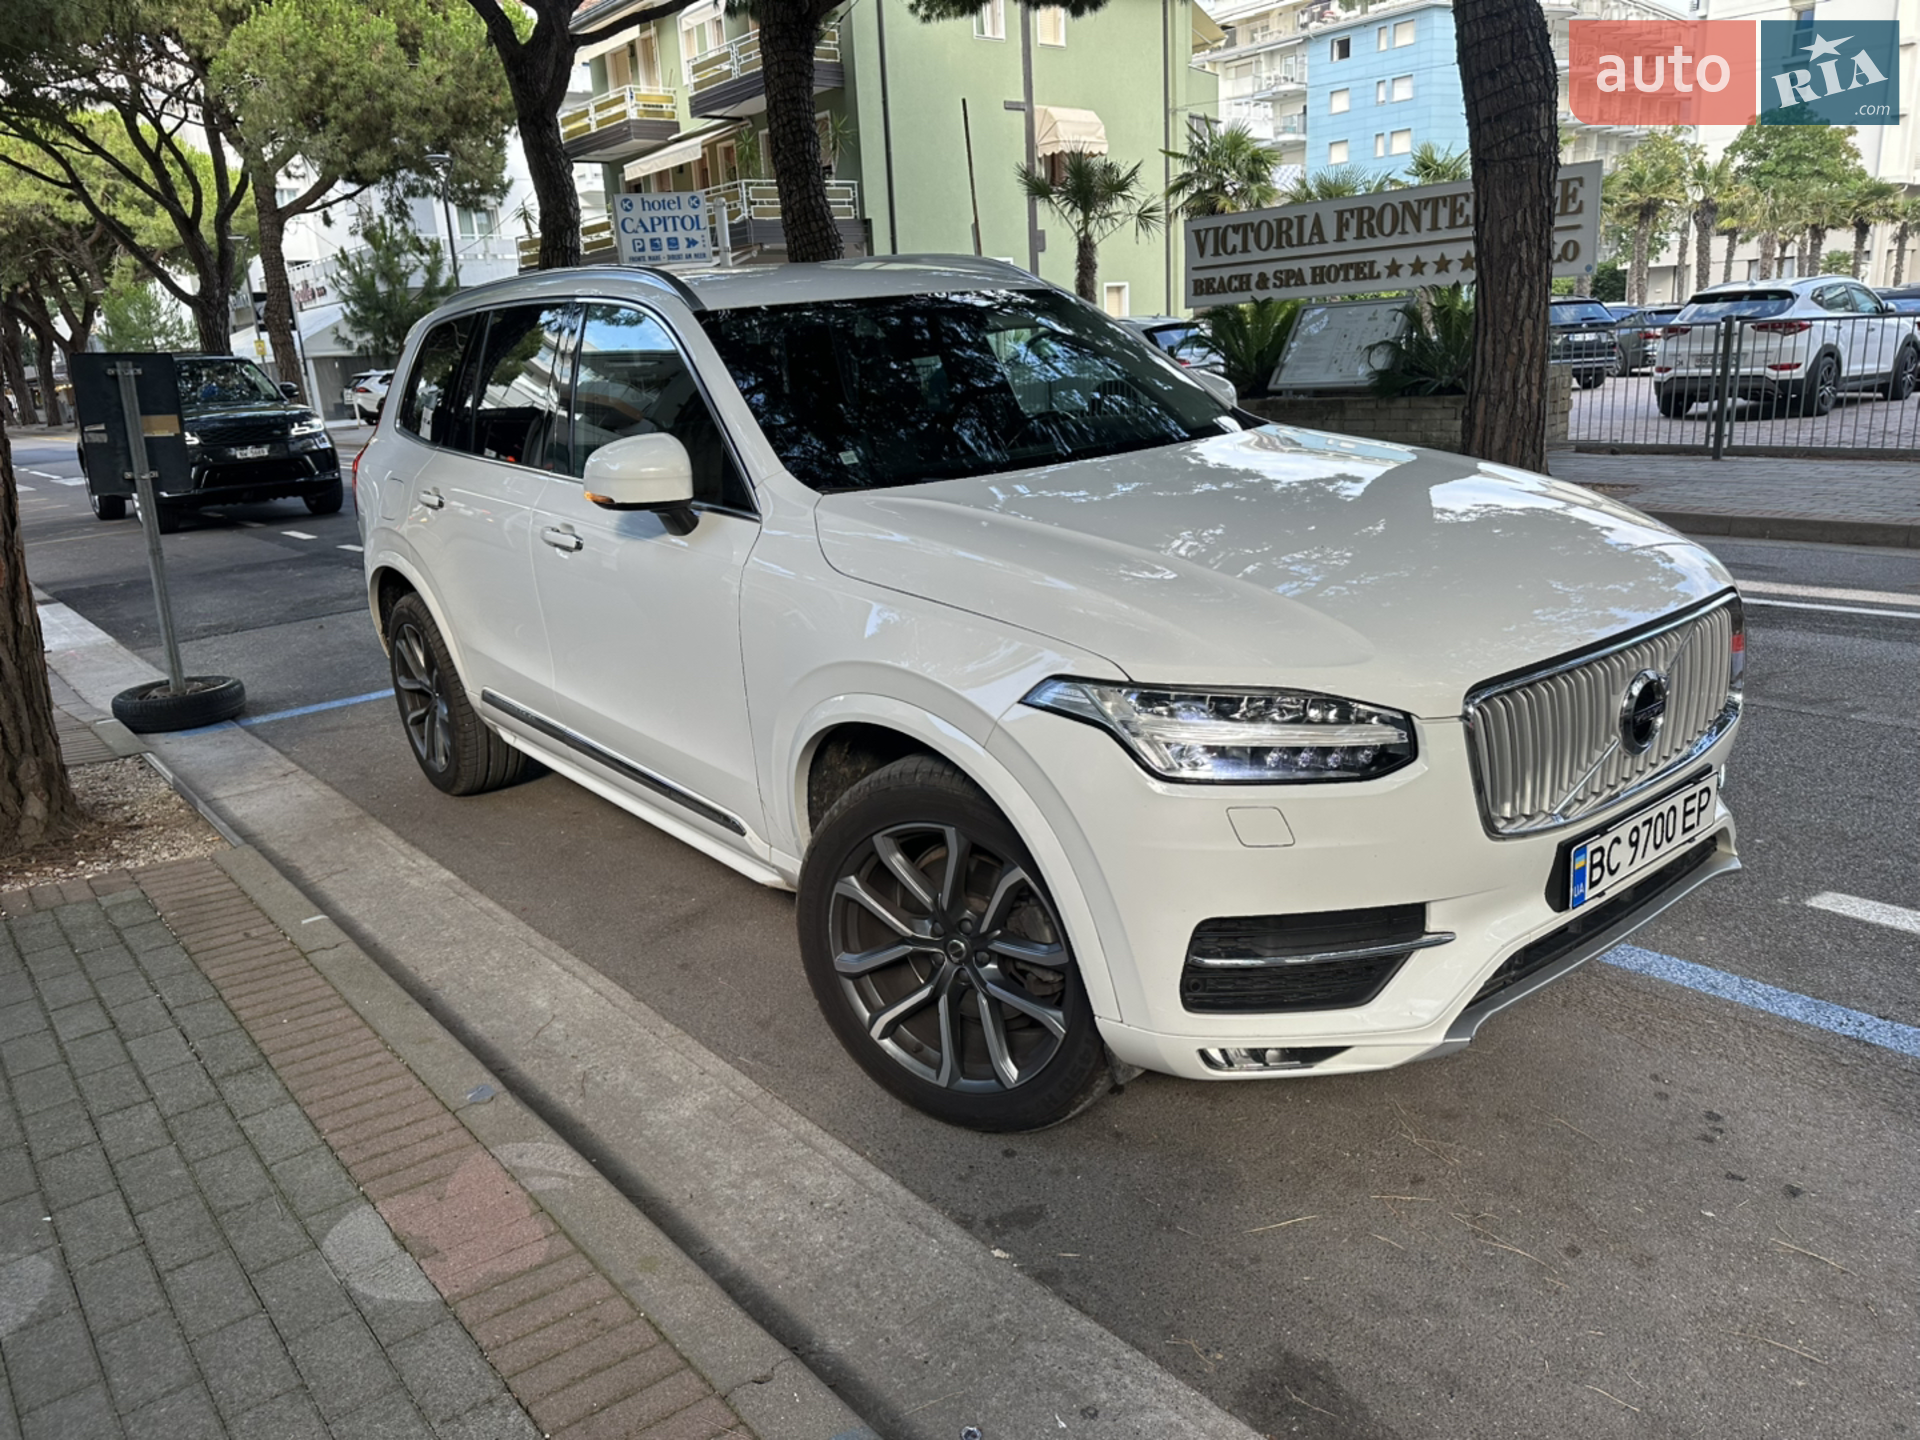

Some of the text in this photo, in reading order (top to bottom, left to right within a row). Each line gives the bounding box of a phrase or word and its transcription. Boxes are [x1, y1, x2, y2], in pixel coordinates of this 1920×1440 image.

[641, 196, 682, 212] hotel
[620, 214, 707, 234] CAPITOL
[1191, 212, 1329, 259] VICTORIA
[1191, 260, 1382, 297] BEACH & SPA HOTEL
[1573, 786, 1712, 898] UA BC 9700 EP
